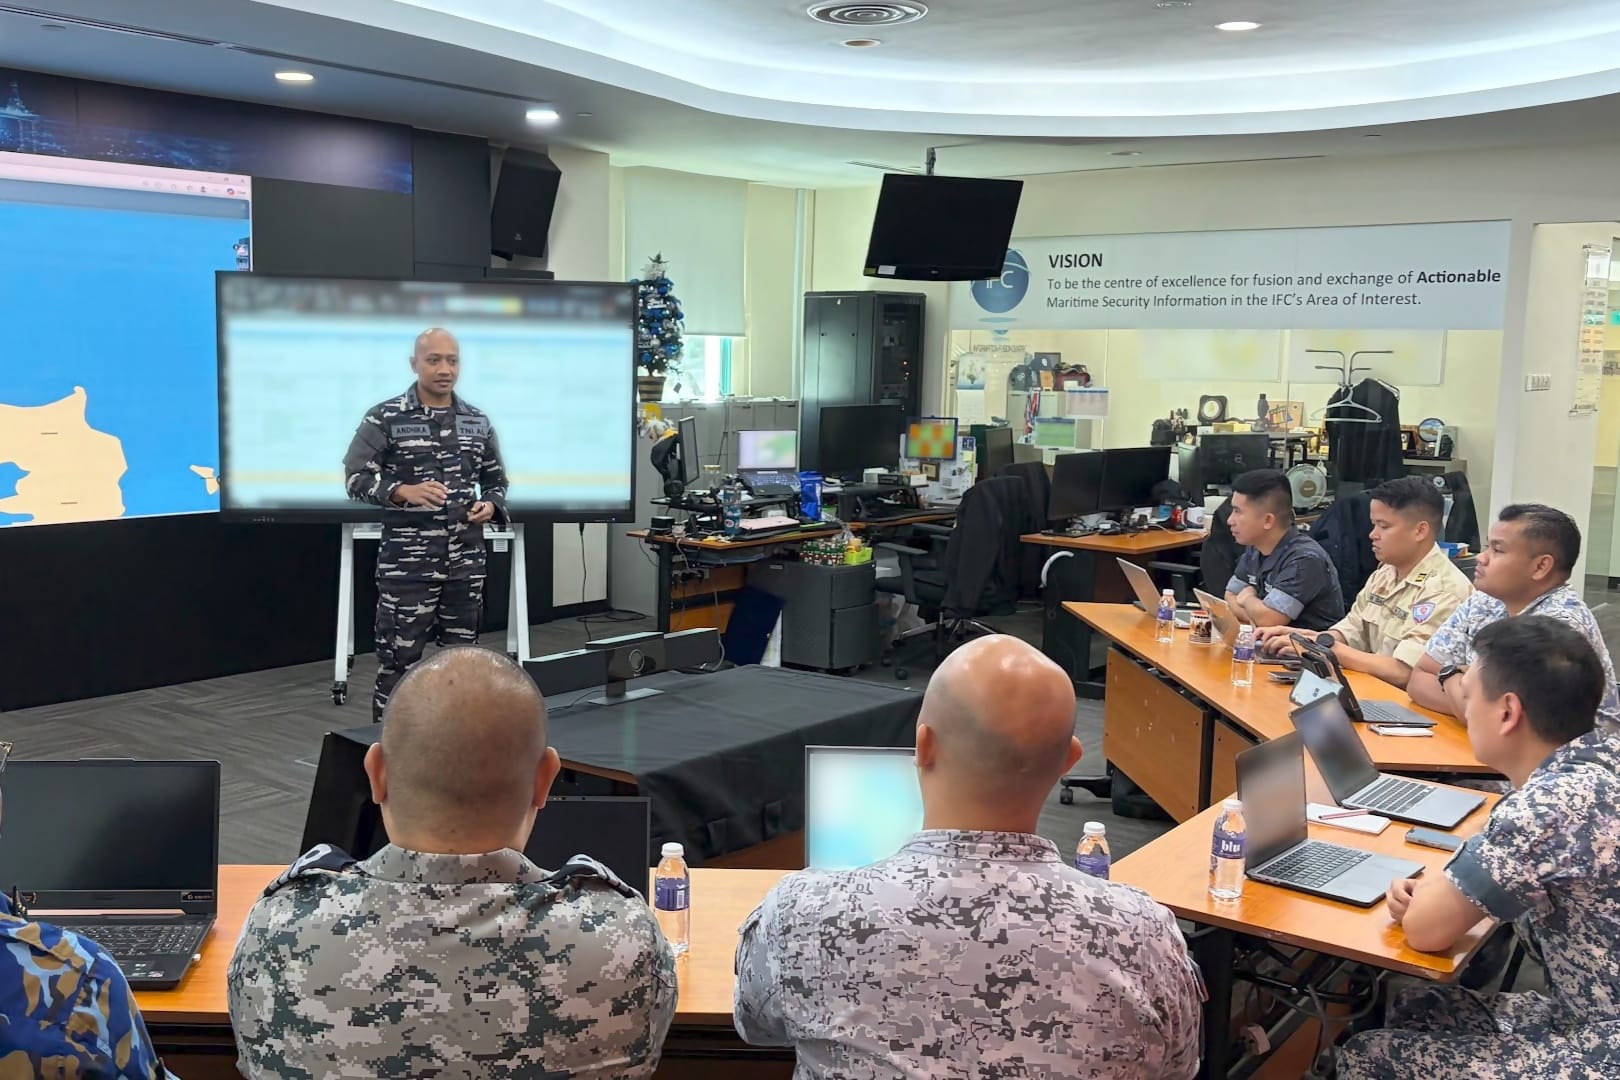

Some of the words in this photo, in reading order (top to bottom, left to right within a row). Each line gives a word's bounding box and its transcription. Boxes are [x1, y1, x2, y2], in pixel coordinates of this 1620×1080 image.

[1048, 252, 1103, 268] VISION
[1047, 278, 1062, 290] To
[1064, 277, 1079, 289] be
[1081, 276, 1101, 289] the
[1103, 277, 1143, 289] centre
[1145, 275, 1160, 288] of
[1161, 274, 1227, 288] excellence
[1229, 273, 1250, 287] for
[1252, 273, 1293, 287] fusion
[1296, 272, 1323, 286] and
[1326, 271, 1394, 288] exchange
[1397, 270, 1414, 284] of
[1416, 268, 1502, 284] Actionable
[1046, 296, 1099, 308] Maritime
[1101, 295, 1151, 310] Security
[1153, 294, 1227, 307] Information
[1230, 293, 1243, 306] in
[1246, 293, 1269, 306] the
[1271, 292, 1303, 306] IFC’s
[1305, 293, 1338, 306] Area
[1342, 291, 1359, 306] of
[1360, 292, 1422, 306] Interest.
